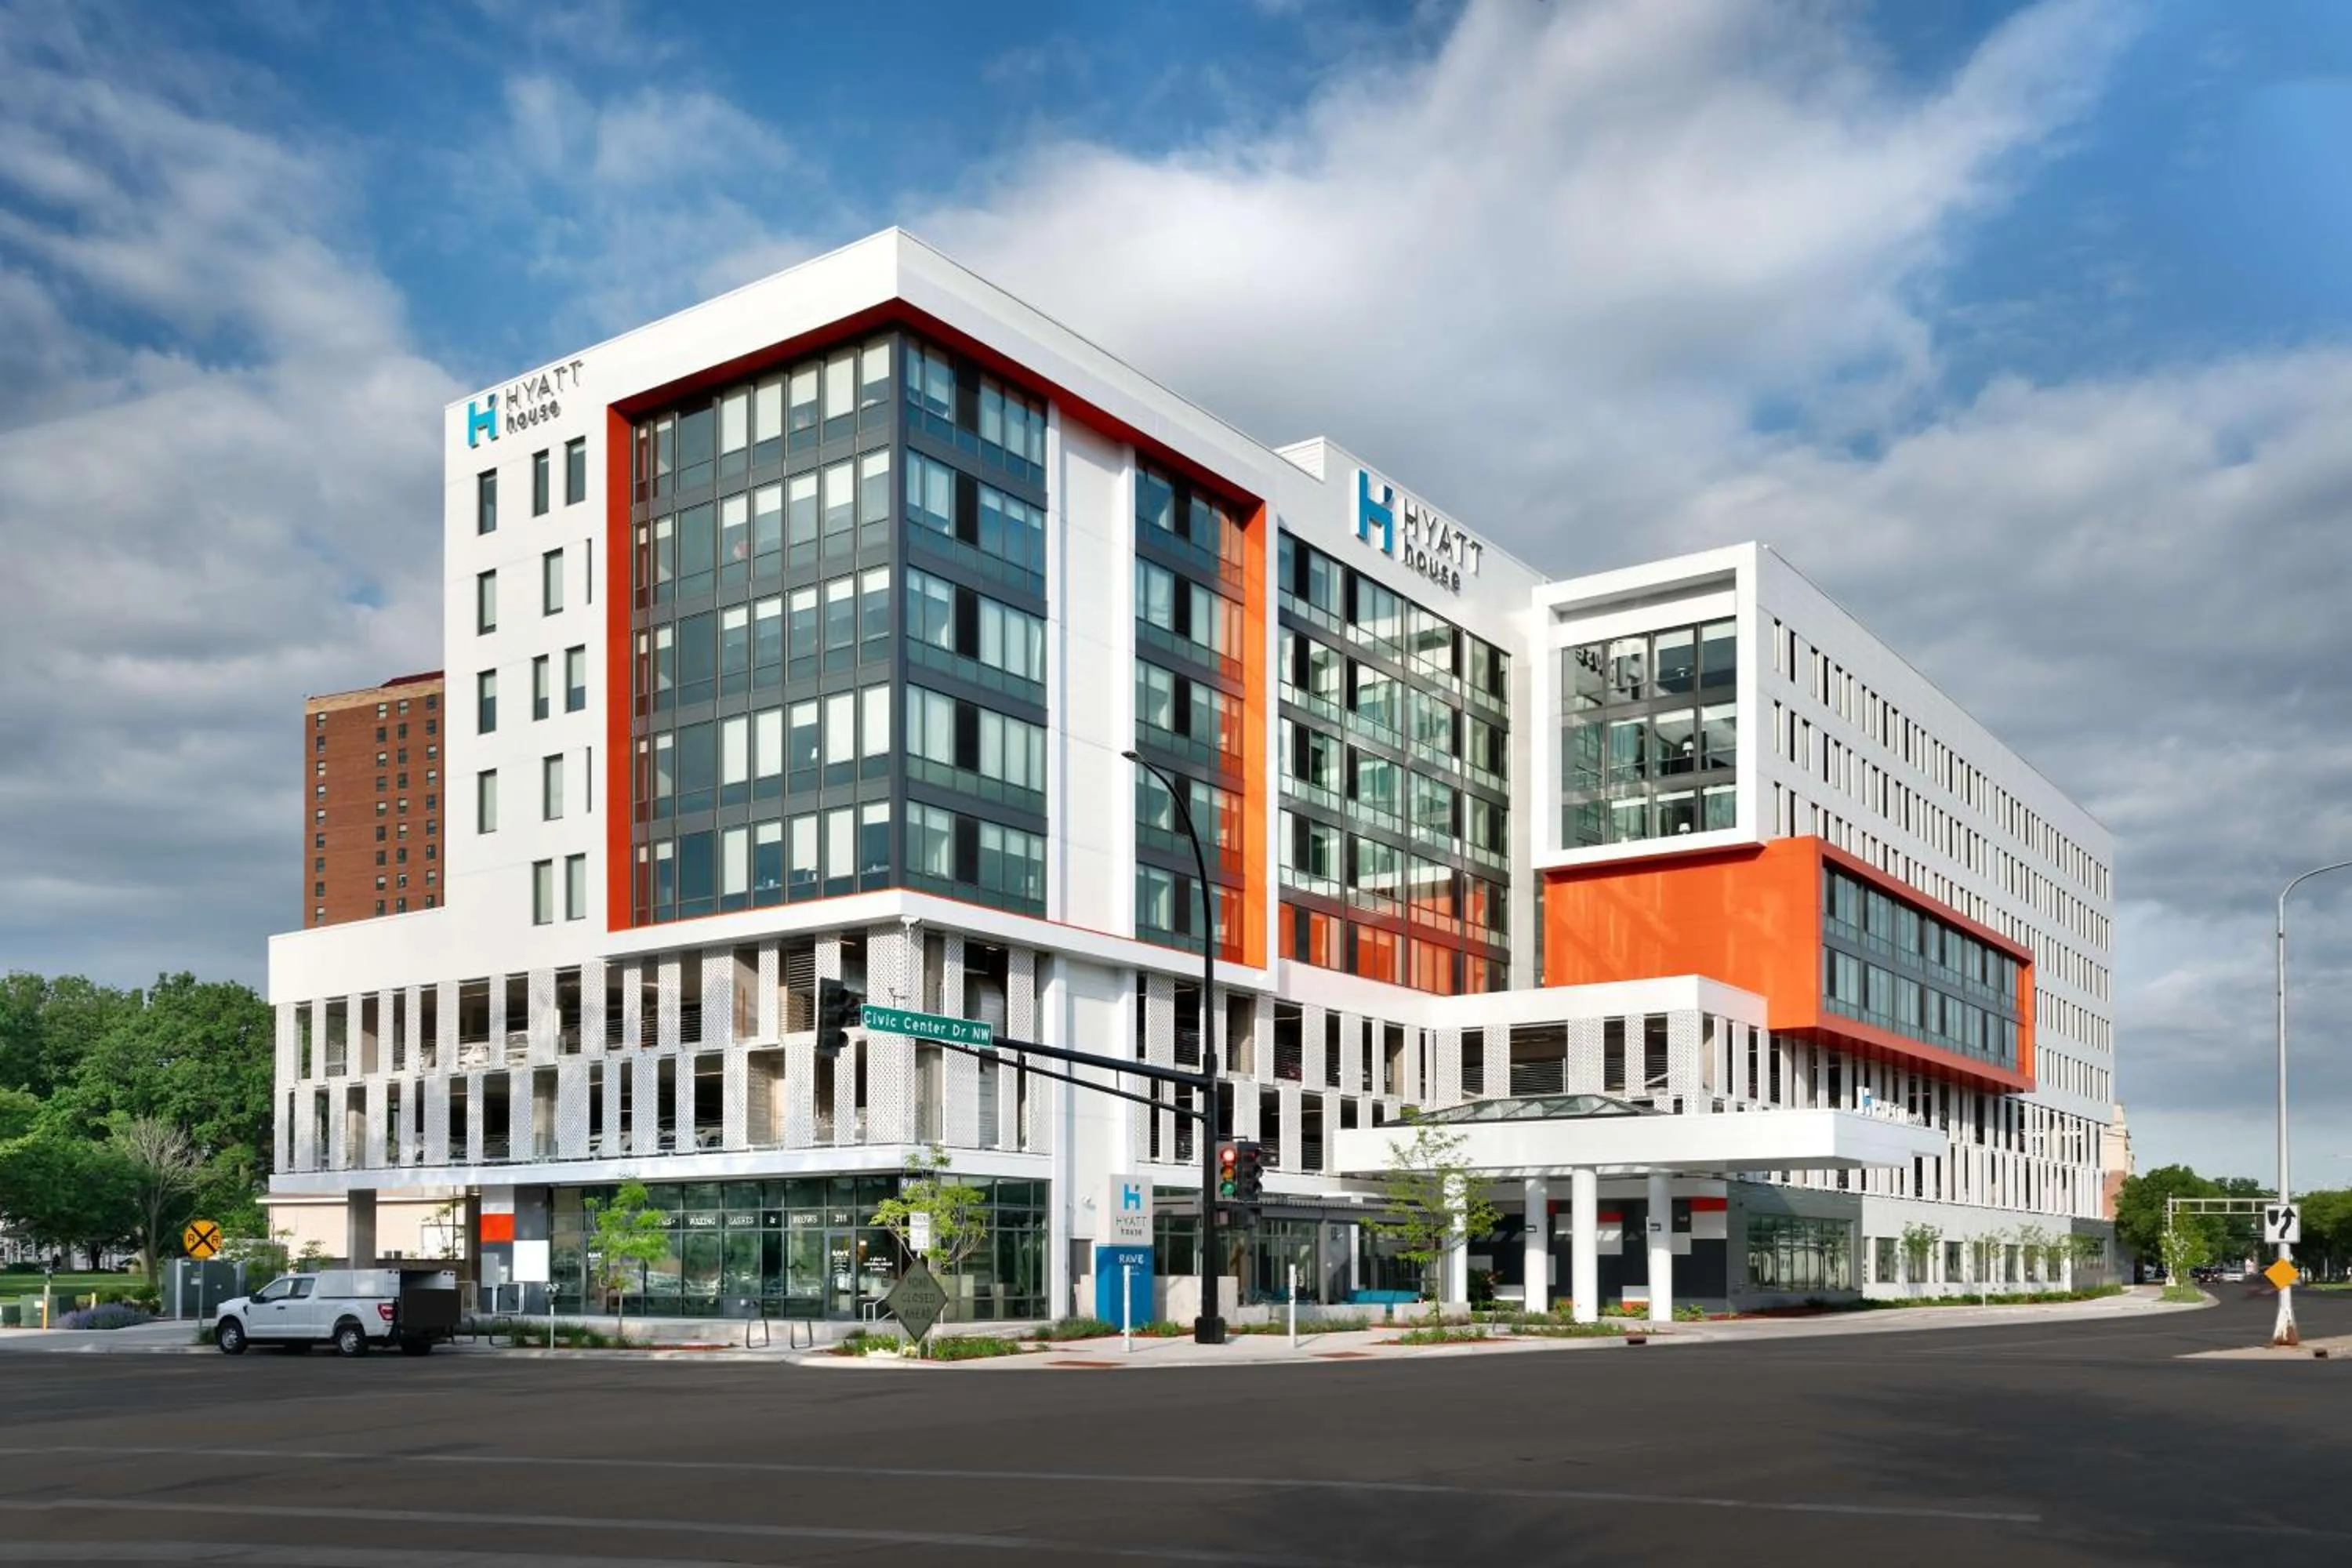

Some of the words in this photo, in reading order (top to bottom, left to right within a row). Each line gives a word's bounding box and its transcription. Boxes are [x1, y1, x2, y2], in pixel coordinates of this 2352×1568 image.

[506, 360, 584, 409] HYATT
[506, 399, 561, 434] house
[1403, 498, 1483, 577] HYATT
[1403, 535, 1461, 591] house
[863, 1011, 897, 1028] Civic
[904, 1017, 946, 1035] Center
[953, 1024, 967, 1036] Dr
[972, 1026, 990, 1041] NW
[1116, 1216, 1147, 1227] HYATT
[900, 1292, 936, 1303] CLOSED
